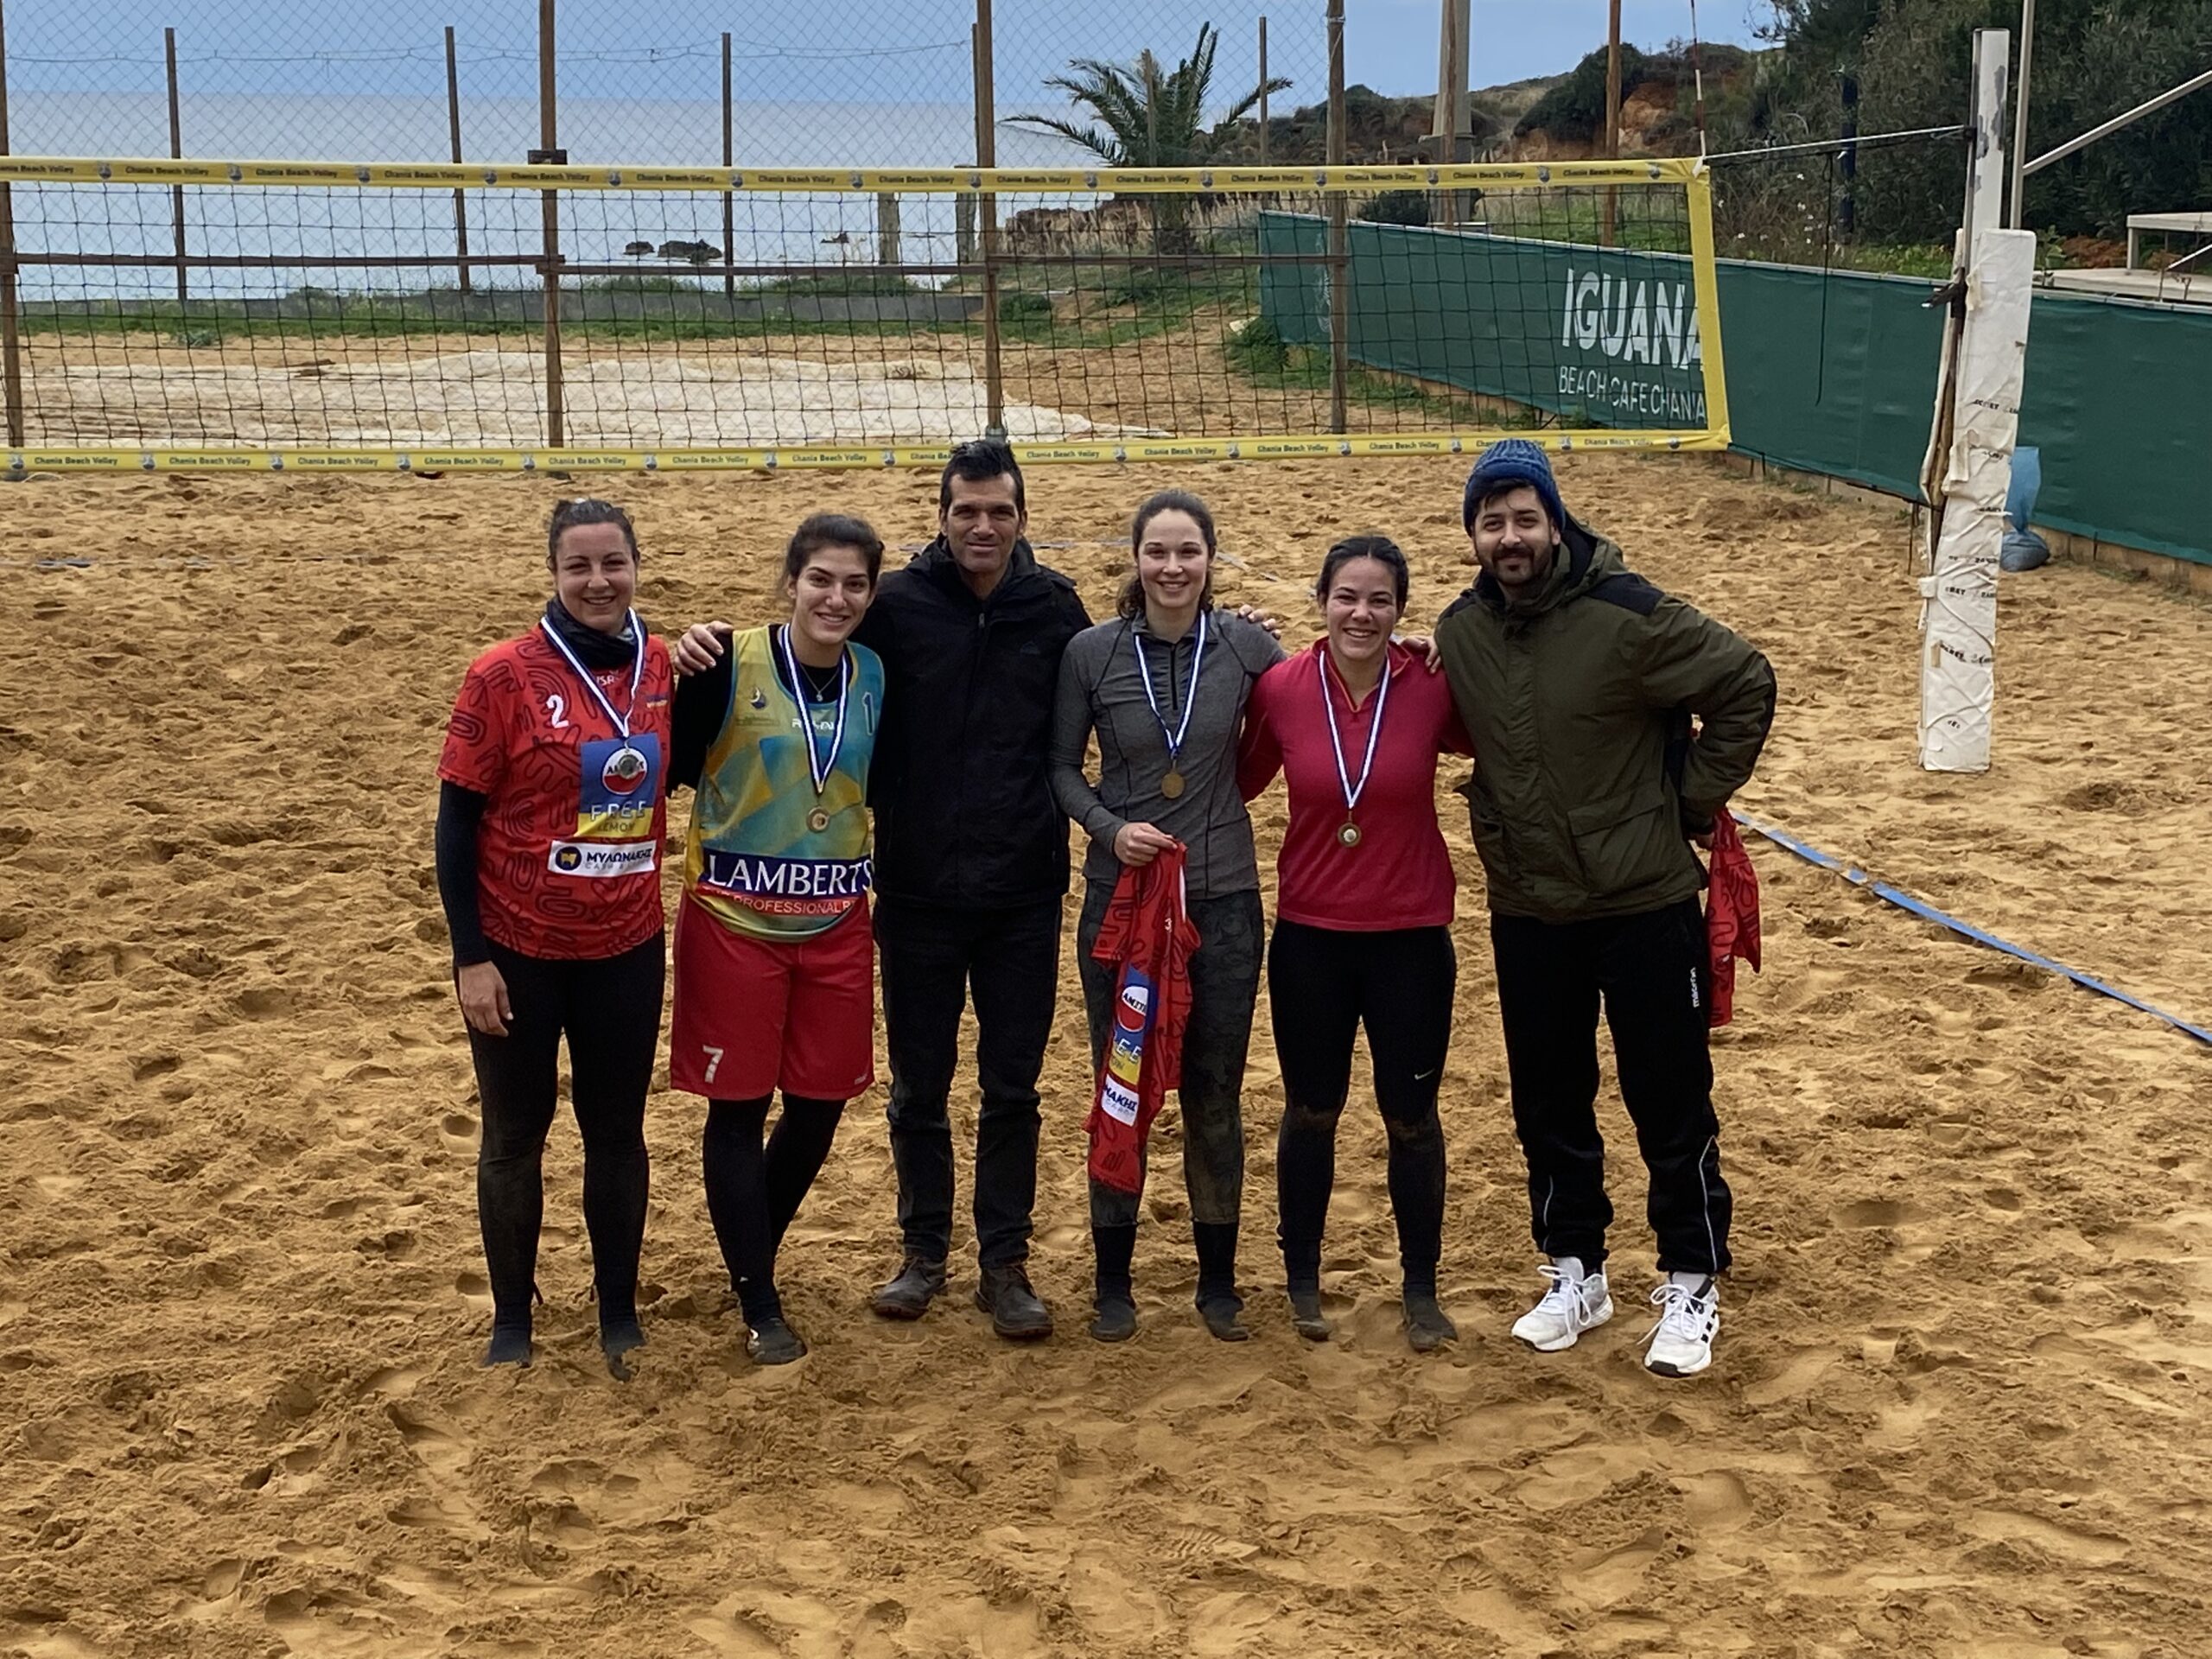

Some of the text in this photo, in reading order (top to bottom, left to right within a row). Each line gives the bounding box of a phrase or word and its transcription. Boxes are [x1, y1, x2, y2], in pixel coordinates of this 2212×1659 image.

[1562, 268, 1701, 370] IGUANA
[1559, 365, 1607, 402] BEACH
[1611, 377, 1648, 412] CAFE
[546, 694, 569, 728] 2
[708, 854, 873, 897] LAMBERTS
[702, 1045, 724, 1084] 7
